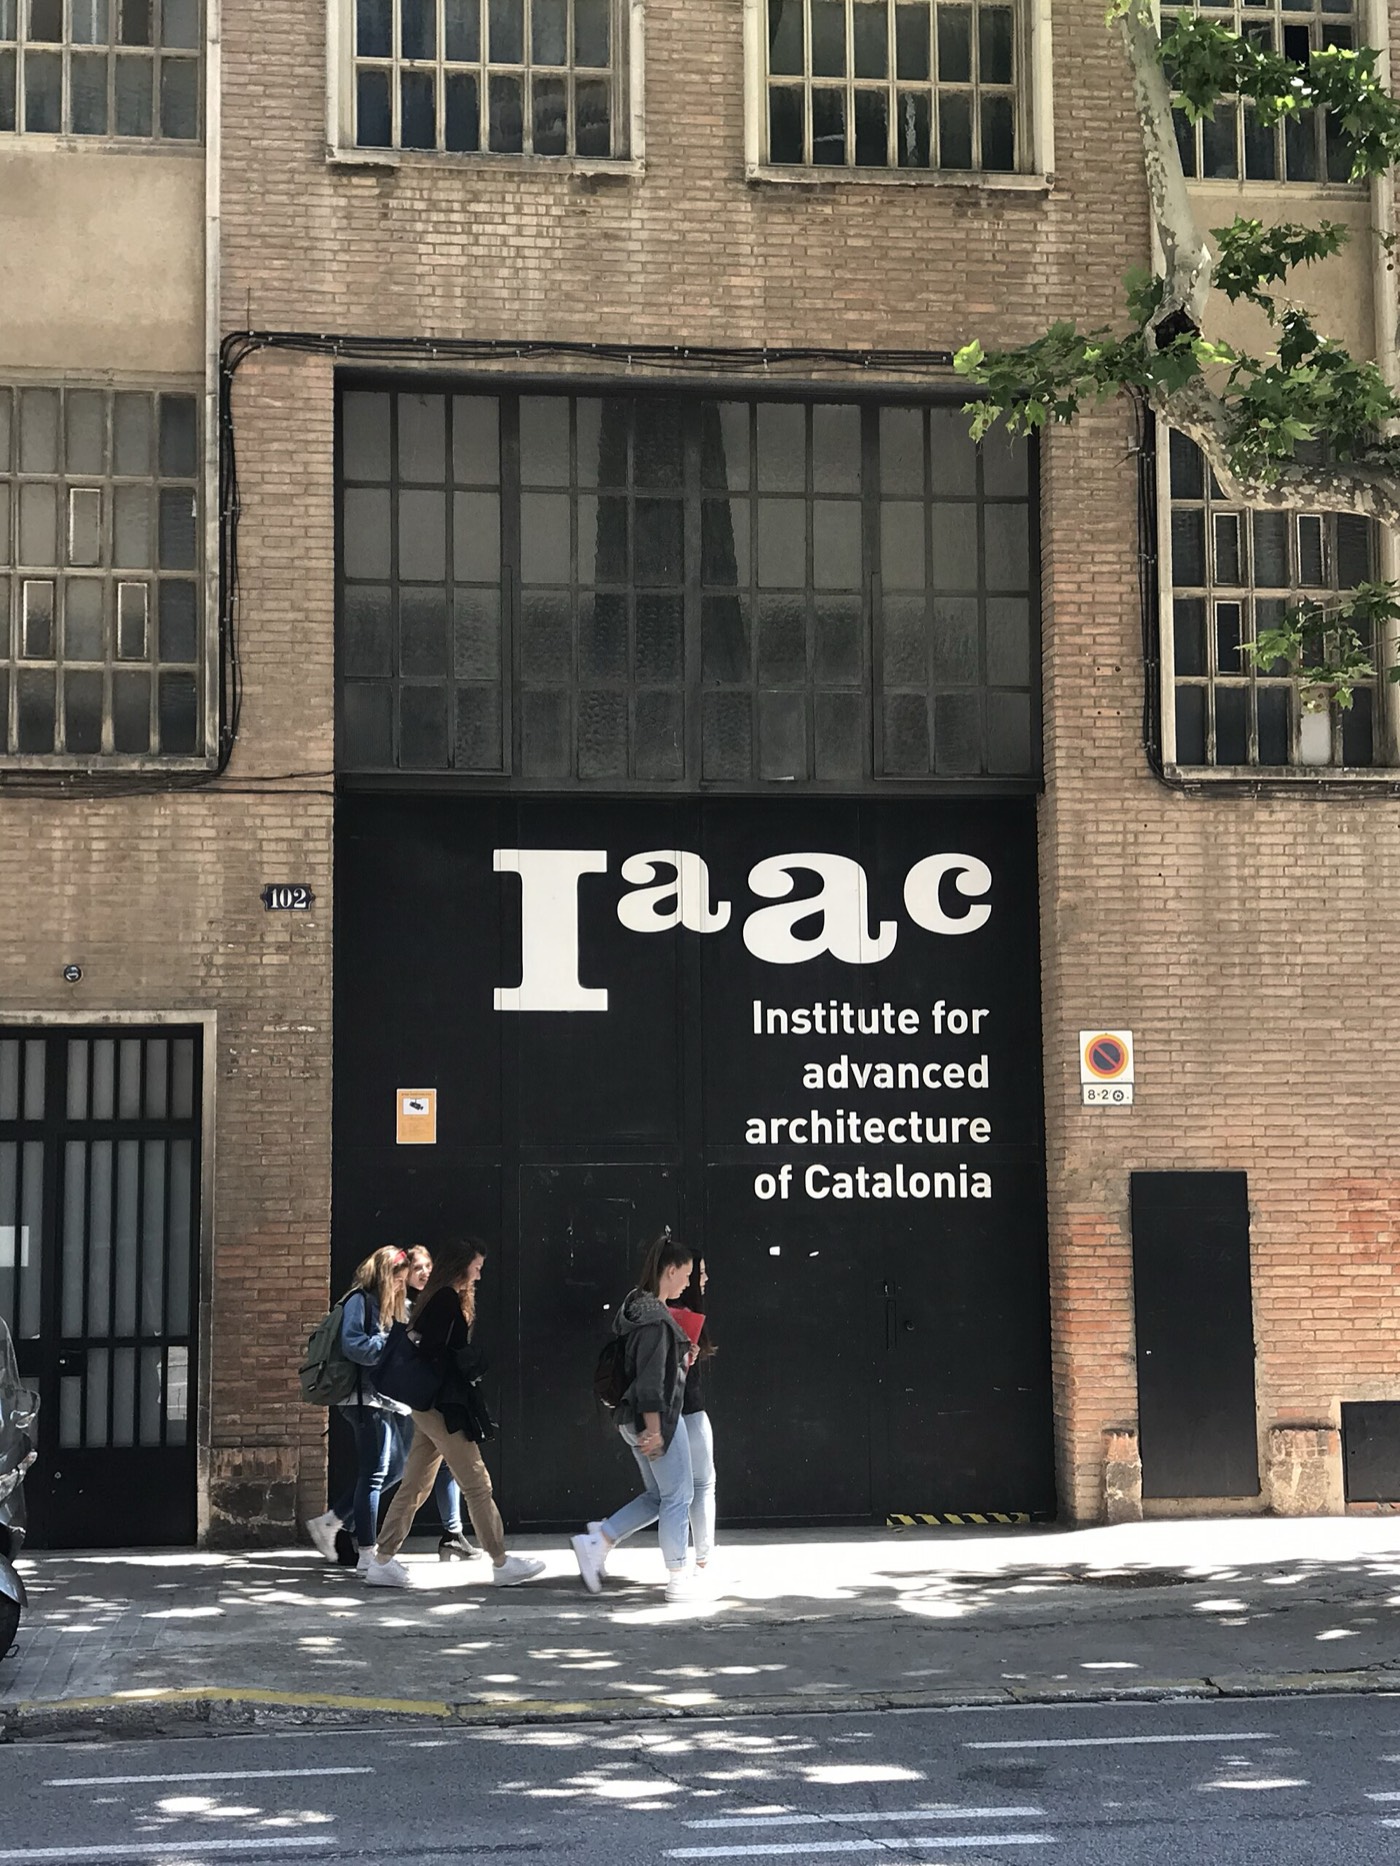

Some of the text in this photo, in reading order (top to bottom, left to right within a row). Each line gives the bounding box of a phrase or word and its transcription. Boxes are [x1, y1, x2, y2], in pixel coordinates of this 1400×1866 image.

[270, 887, 307, 909] 102
[493, 849, 992, 1012] Iaac
[753, 999, 990, 1035] Institute for
[802, 1054, 989, 1089] advanced
[745, 1109, 992, 1145] architecture
[754, 1163, 992, 1200] of Catalonia
